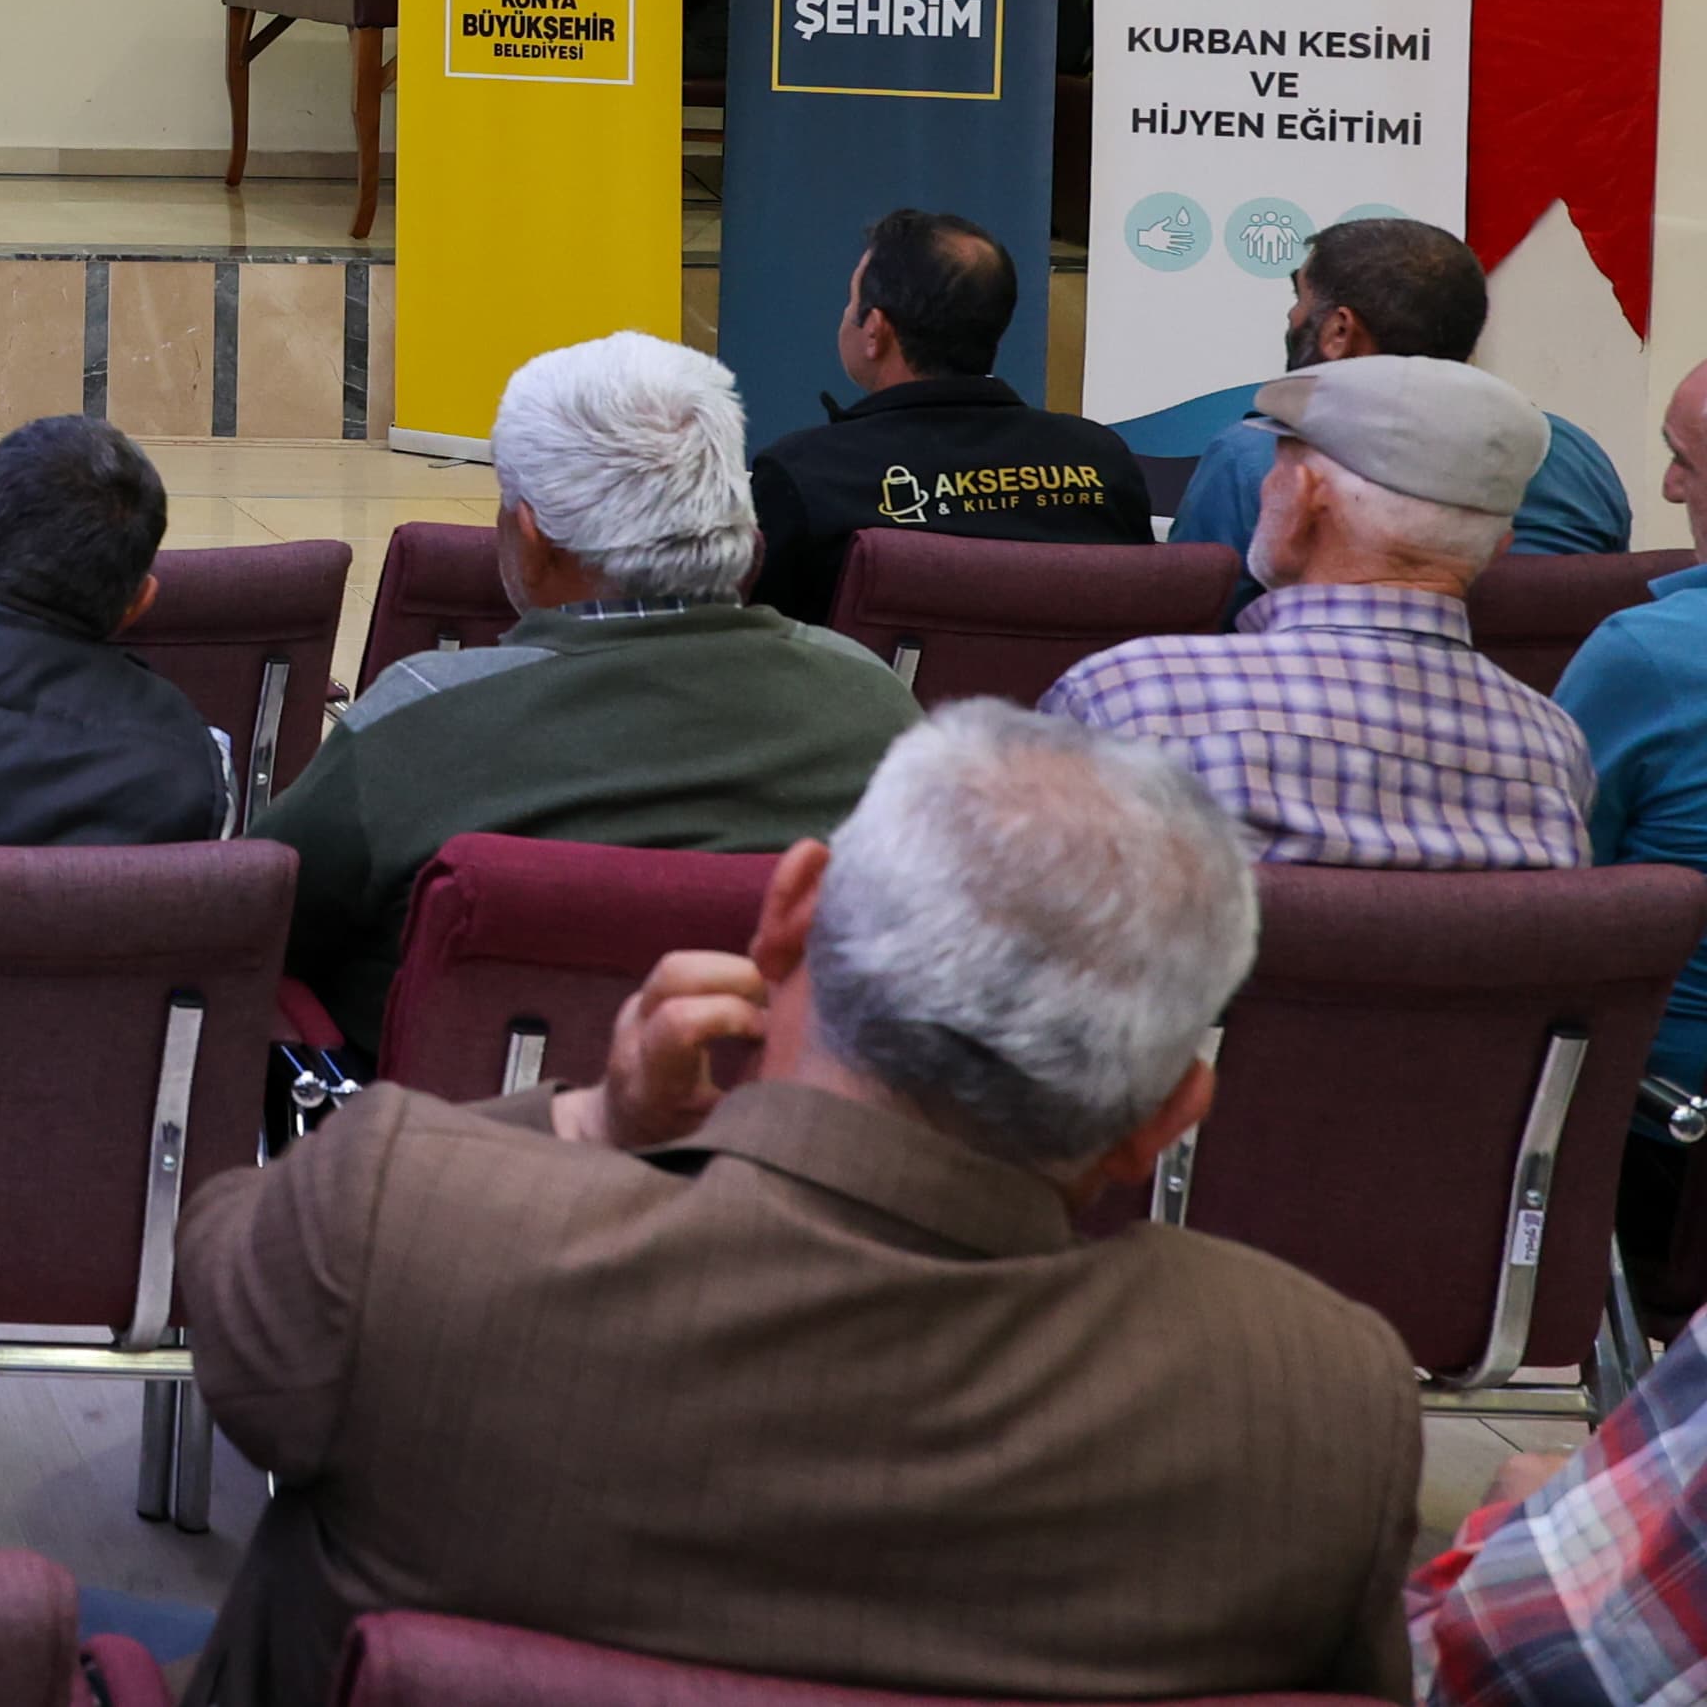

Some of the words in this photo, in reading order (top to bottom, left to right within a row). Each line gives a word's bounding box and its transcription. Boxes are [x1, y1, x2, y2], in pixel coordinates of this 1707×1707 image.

[462, 8, 616, 43] BÜYÜKŞEHİR
[493, 42, 584, 60] BELEDİYESİ
[1128, 26, 1287, 57] KURBAN
[1298, 25, 1431, 61] KESİMİ
[1249, 70, 1300, 98] VE
[1131, 102, 1265, 138] HİJYEN
[1277, 107, 1422, 145] EĞİTİMİ
[934, 465, 1105, 499] AKSESUAR
[937, 502, 951, 516] &
[963, 496, 1020, 513] KILIF
[1036, 492, 1105, 507] STORE
